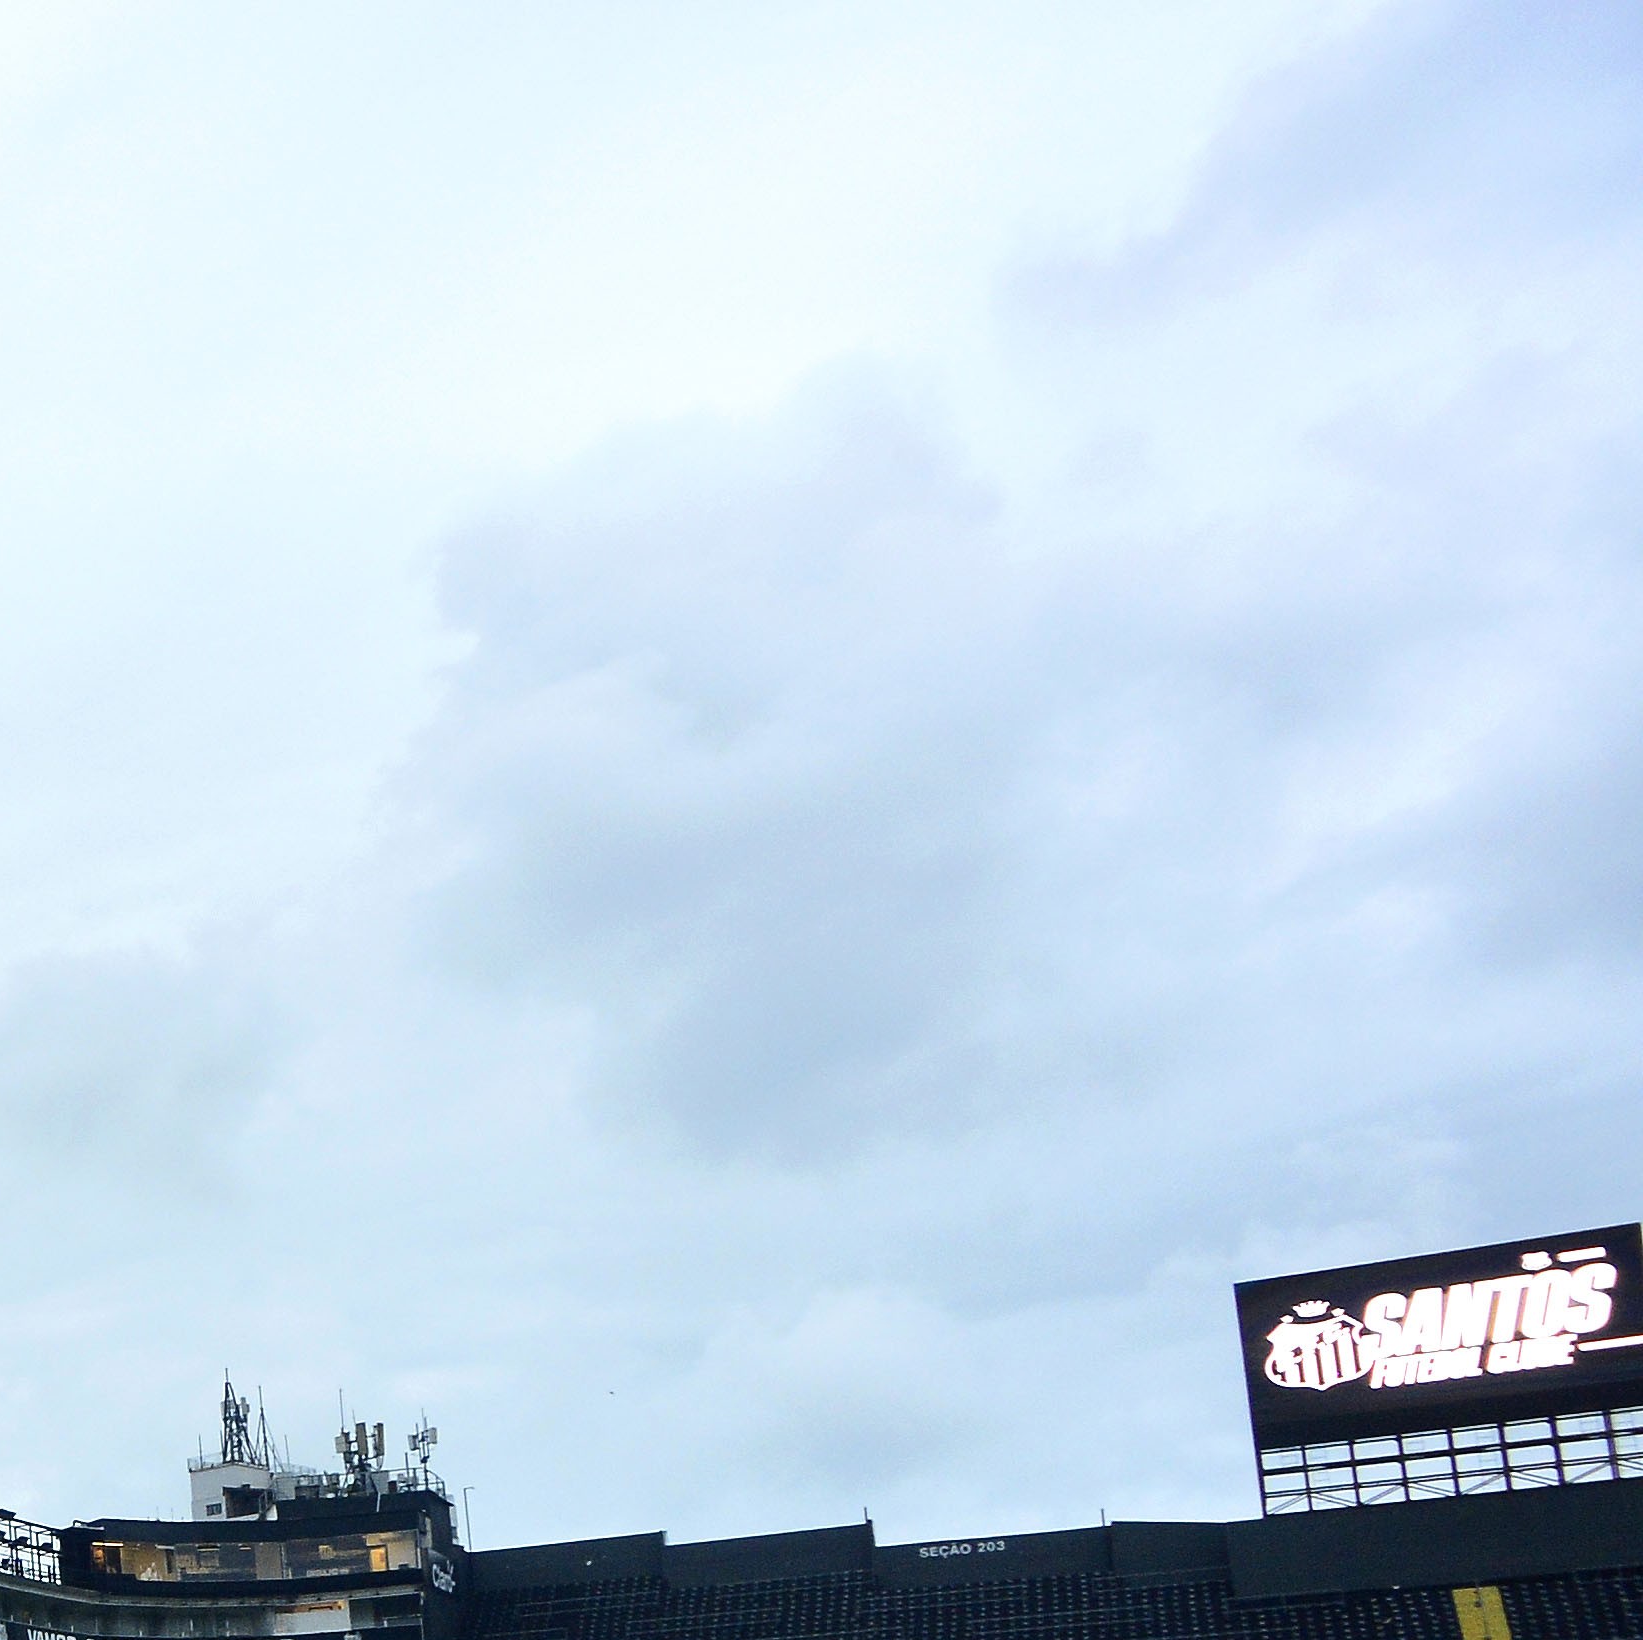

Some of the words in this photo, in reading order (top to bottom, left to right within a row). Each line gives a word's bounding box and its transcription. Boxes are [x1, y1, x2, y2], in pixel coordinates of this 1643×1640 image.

[1363, 1262, 1618, 1359] SANTOS
[919, 1543, 972, 1560] SEÇÃO
[977, 1540, 1006, 1553] 203
